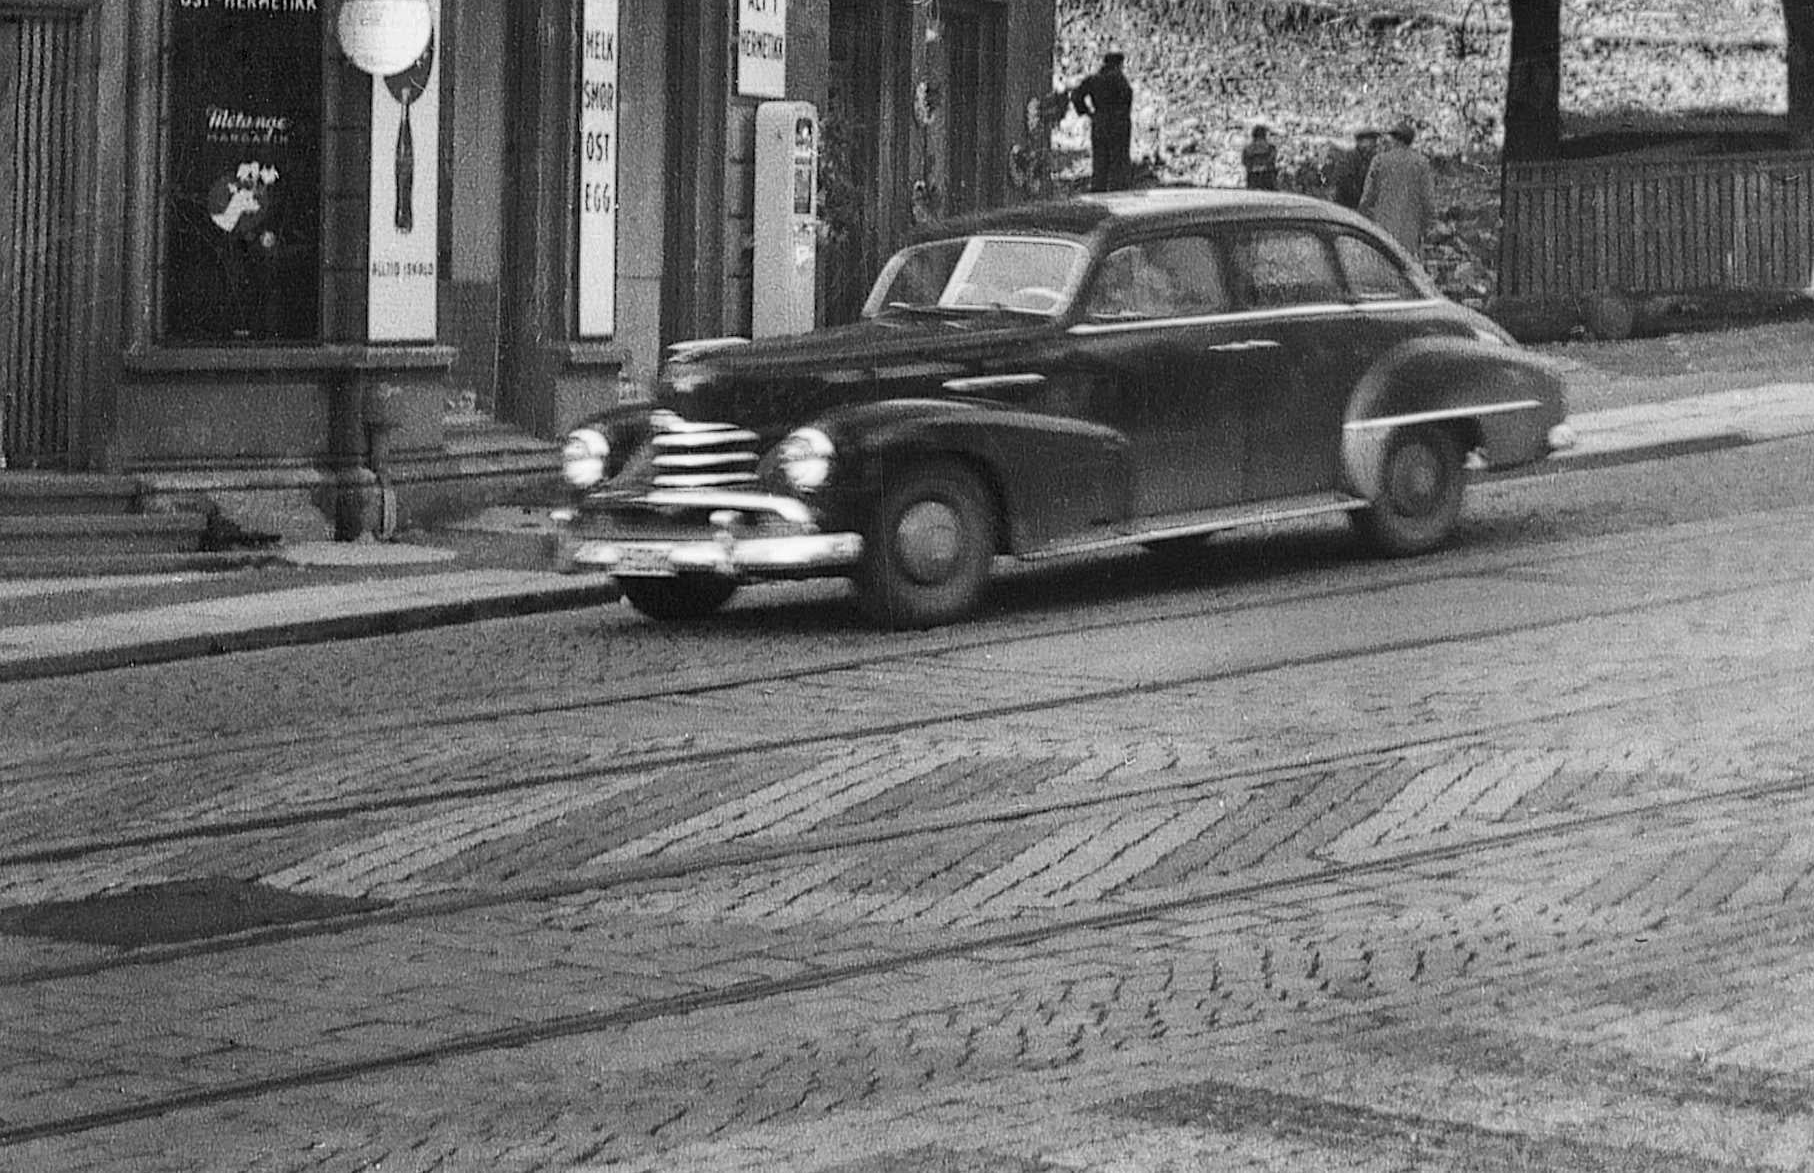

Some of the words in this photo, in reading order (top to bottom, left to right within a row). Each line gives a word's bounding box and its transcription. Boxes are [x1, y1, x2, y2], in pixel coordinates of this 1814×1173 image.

[584, 30, 615, 62] MELK
[586, 131, 611, 163] OST
[584, 183, 611, 214] EGG
